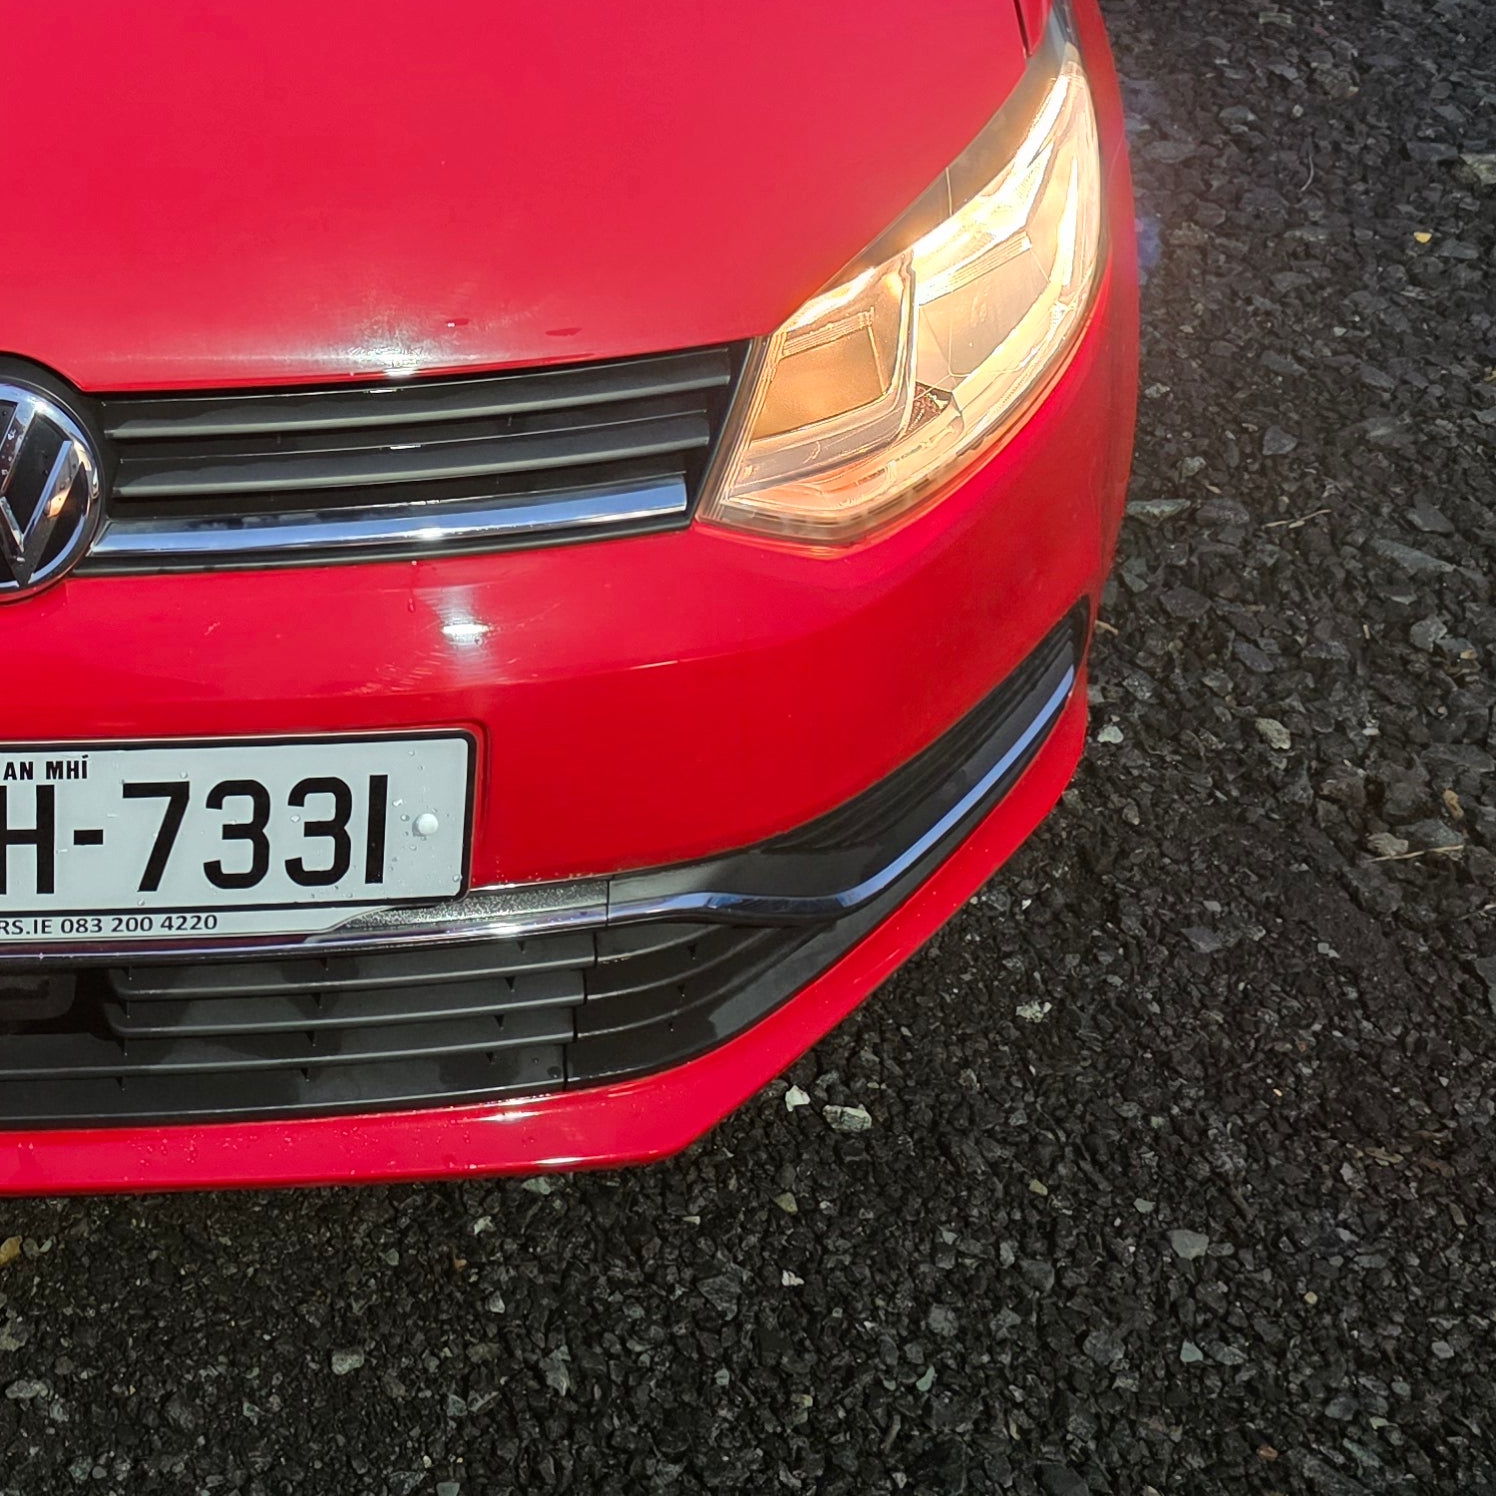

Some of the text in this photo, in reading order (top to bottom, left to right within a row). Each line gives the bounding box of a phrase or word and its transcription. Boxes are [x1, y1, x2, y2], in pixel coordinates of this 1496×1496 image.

[3, 754, 89, 780] AN MHÍ
[60, 917, 103, 935] 083
[111, 916, 154, 933] 200
[160, 914, 218, 932] 4220
